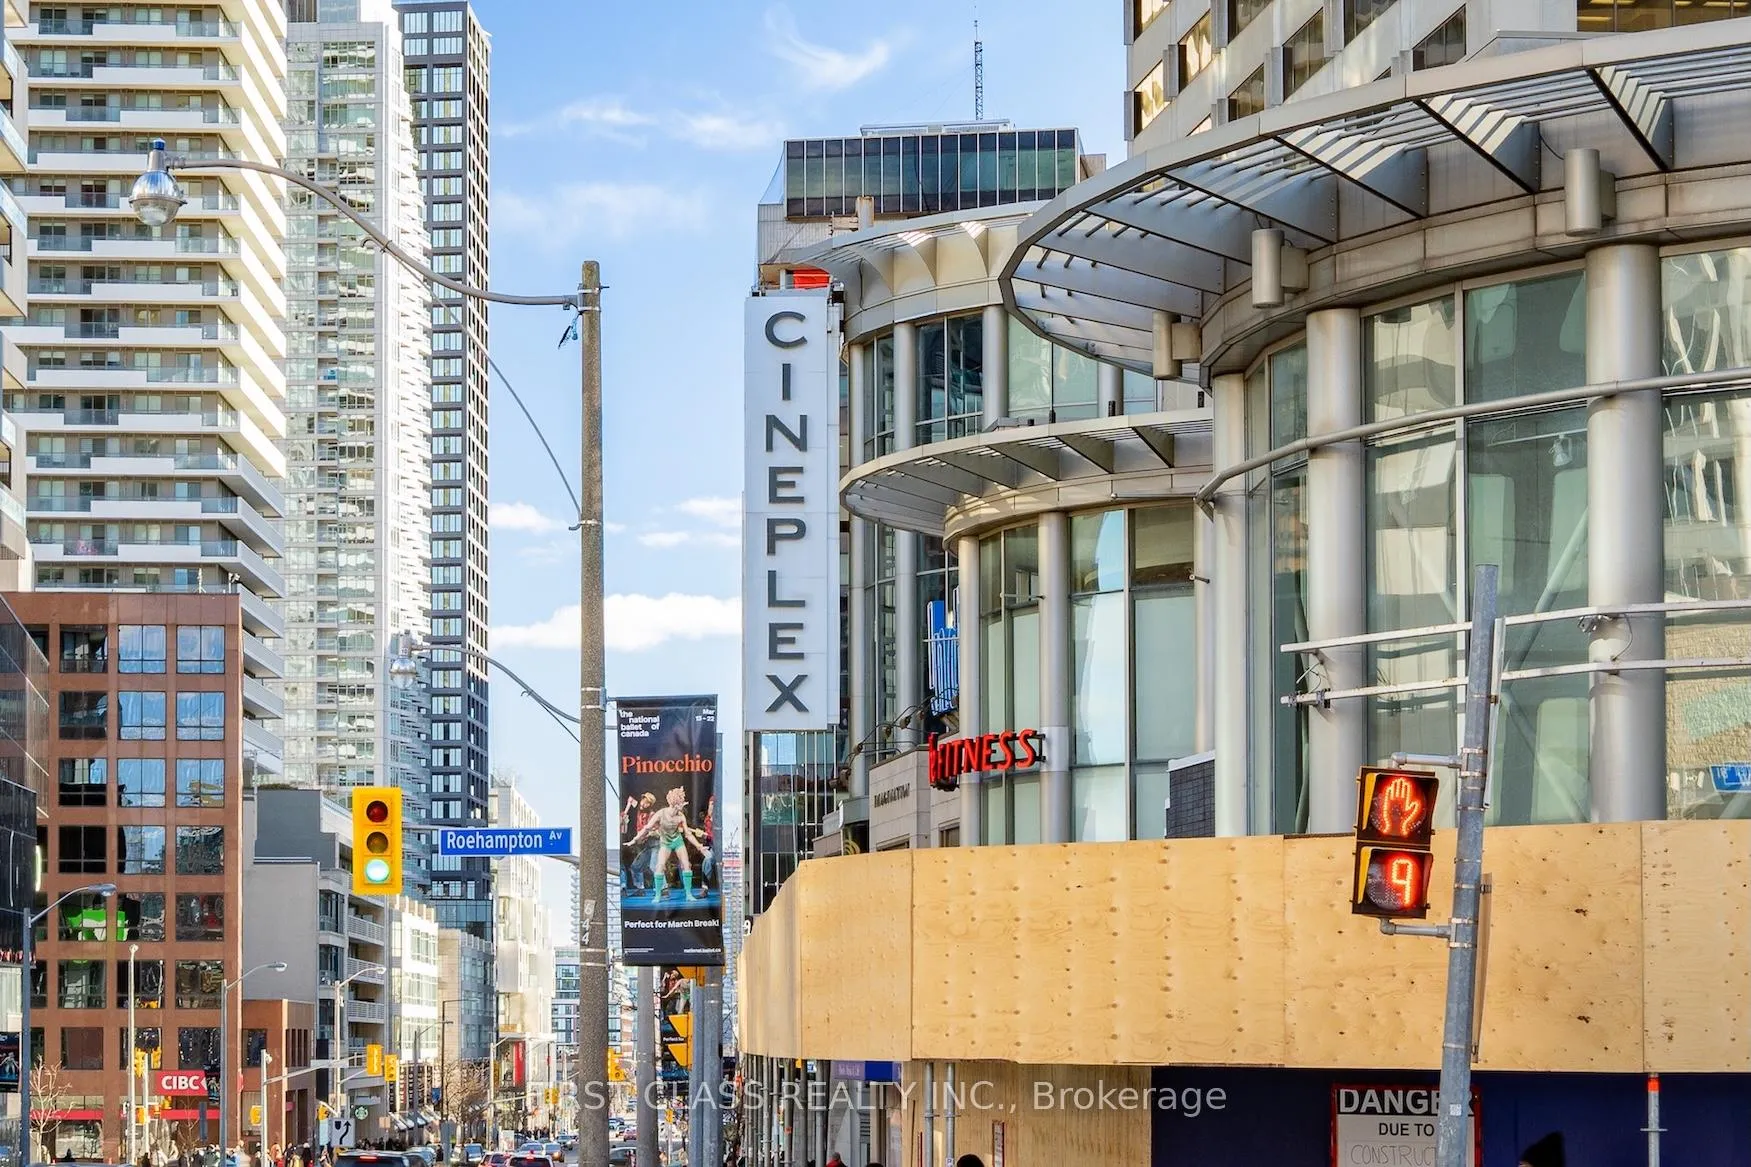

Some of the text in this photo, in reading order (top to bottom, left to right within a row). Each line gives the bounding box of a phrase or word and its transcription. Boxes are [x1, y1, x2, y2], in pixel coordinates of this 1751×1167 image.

[765, 310, 809, 713] CINEPLEX
[619, 710, 633, 718] the
[622, 753, 713, 774] Pinocchio
[447, 831, 563, 853] Roehampton Av
[1391, 858, 1413, 907] 9
[624, 921, 654, 929] Perfect
[668, 920, 694, 928] March
[694, 919, 720, 927] Break!
[161, 1075, 200, 1090] CIBC
[1378, 1122, 1435, 1137] DUE TO
